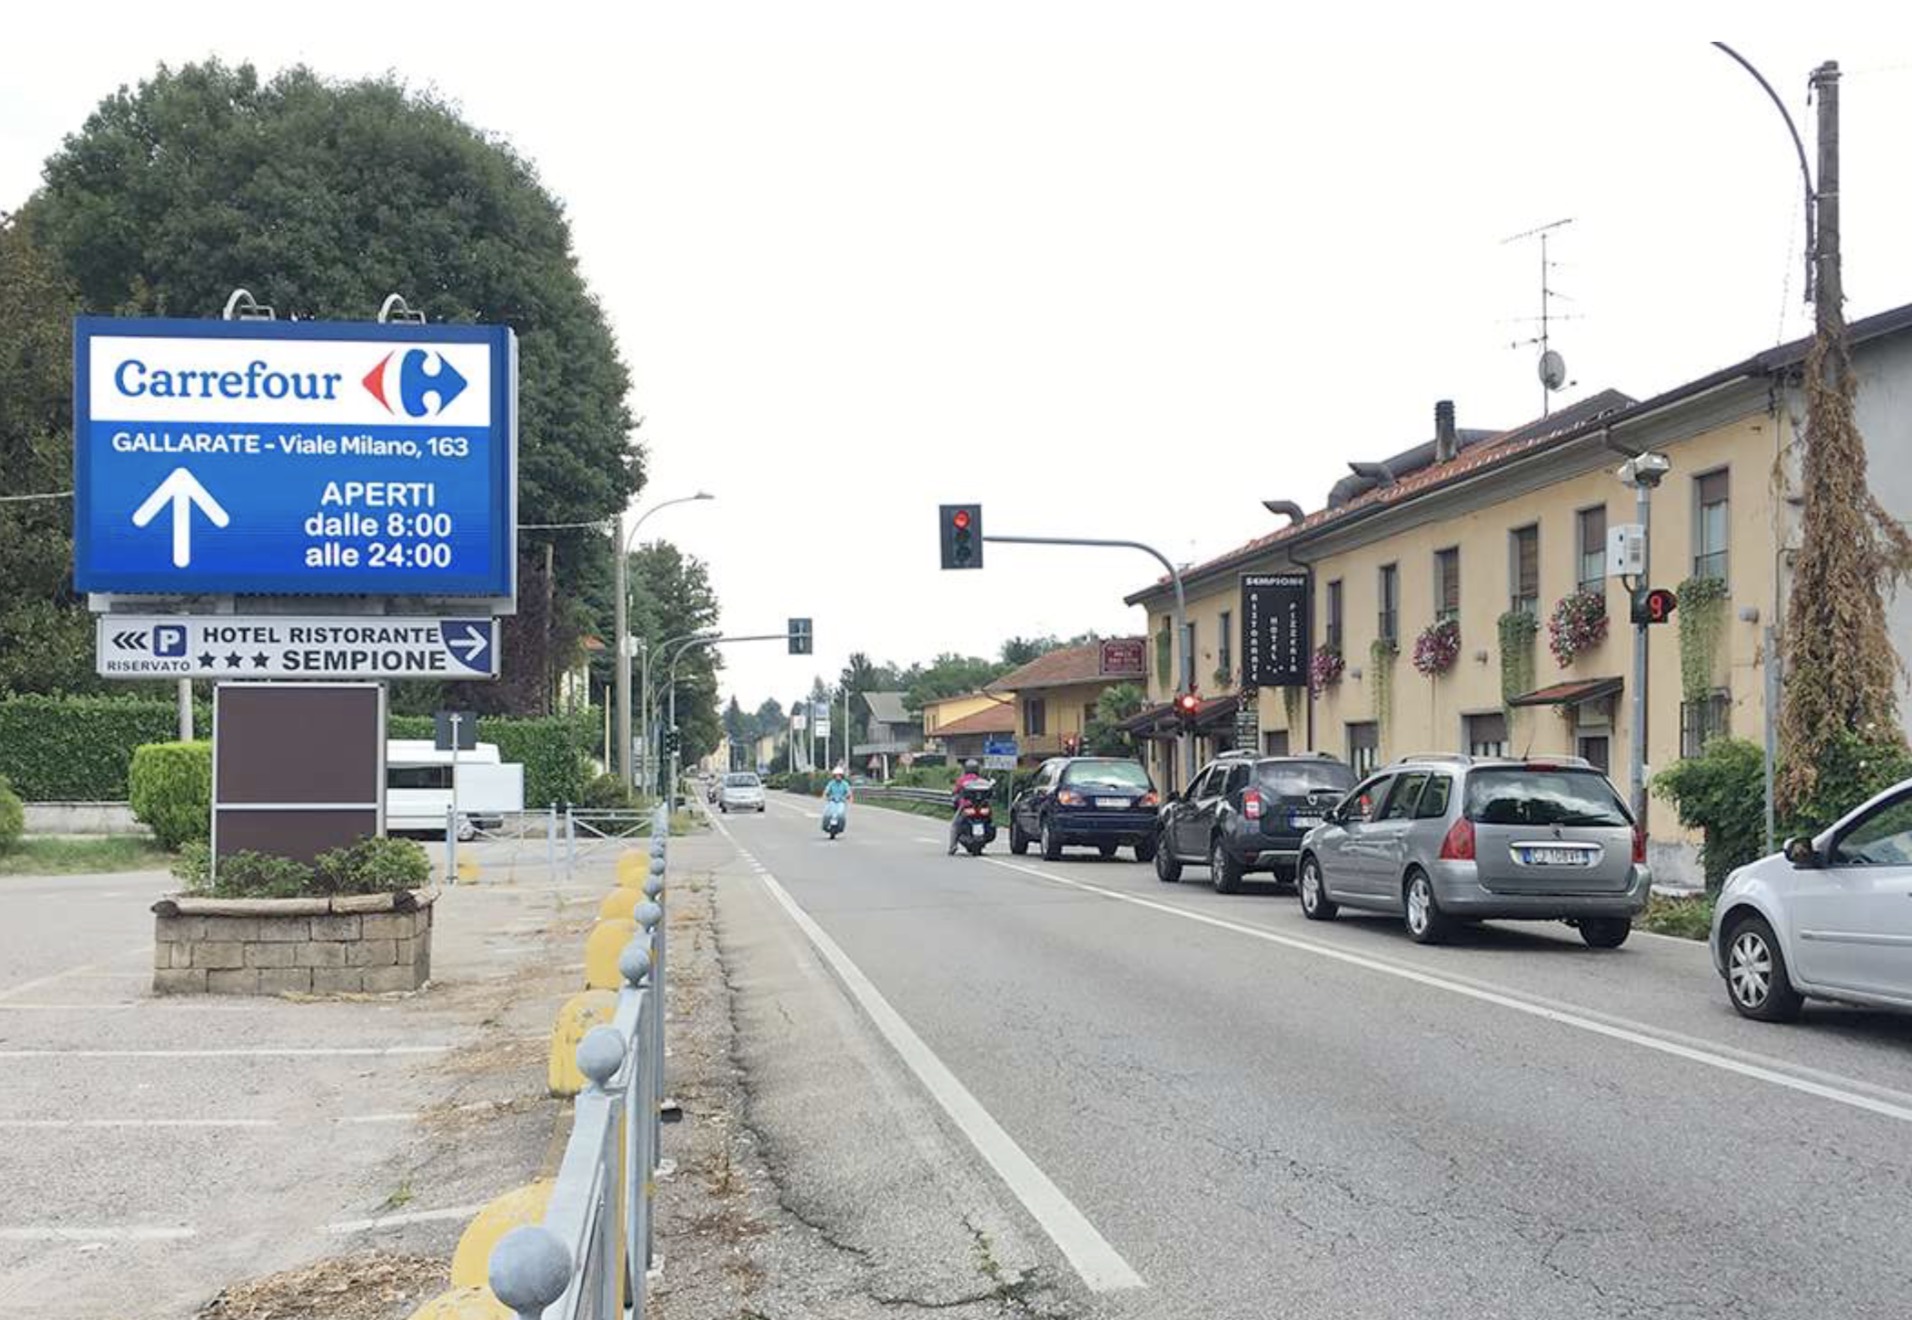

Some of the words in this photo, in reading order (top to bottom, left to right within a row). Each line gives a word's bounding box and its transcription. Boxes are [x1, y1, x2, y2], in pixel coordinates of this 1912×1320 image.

[114, 359, 342, 399] Carrefour
[112, 432, 261, 453] GALLARATE
[279, 433, 337, 455] Viale
[341, 435, 422, 459] Milano,
[427, 437, 469, 457] 163
[320, 481, 435, 507] APERTI
[304, 512, 379, 537] dalle
[387, 513, 452, 538] 8:00
[305, 542, 360, 568] alle
[368, 543, 452, 568] 24:00
[1650, 595, 1662, 618] 9
[159, 629, 181, 654] P
[203, 627, 281, 643] HOTEL
[289, 627, 439, 644] RISTORANTE
[106, 660, 191, 672] RISERVATO
[282, 649, 446, 671] SEMPIONE
